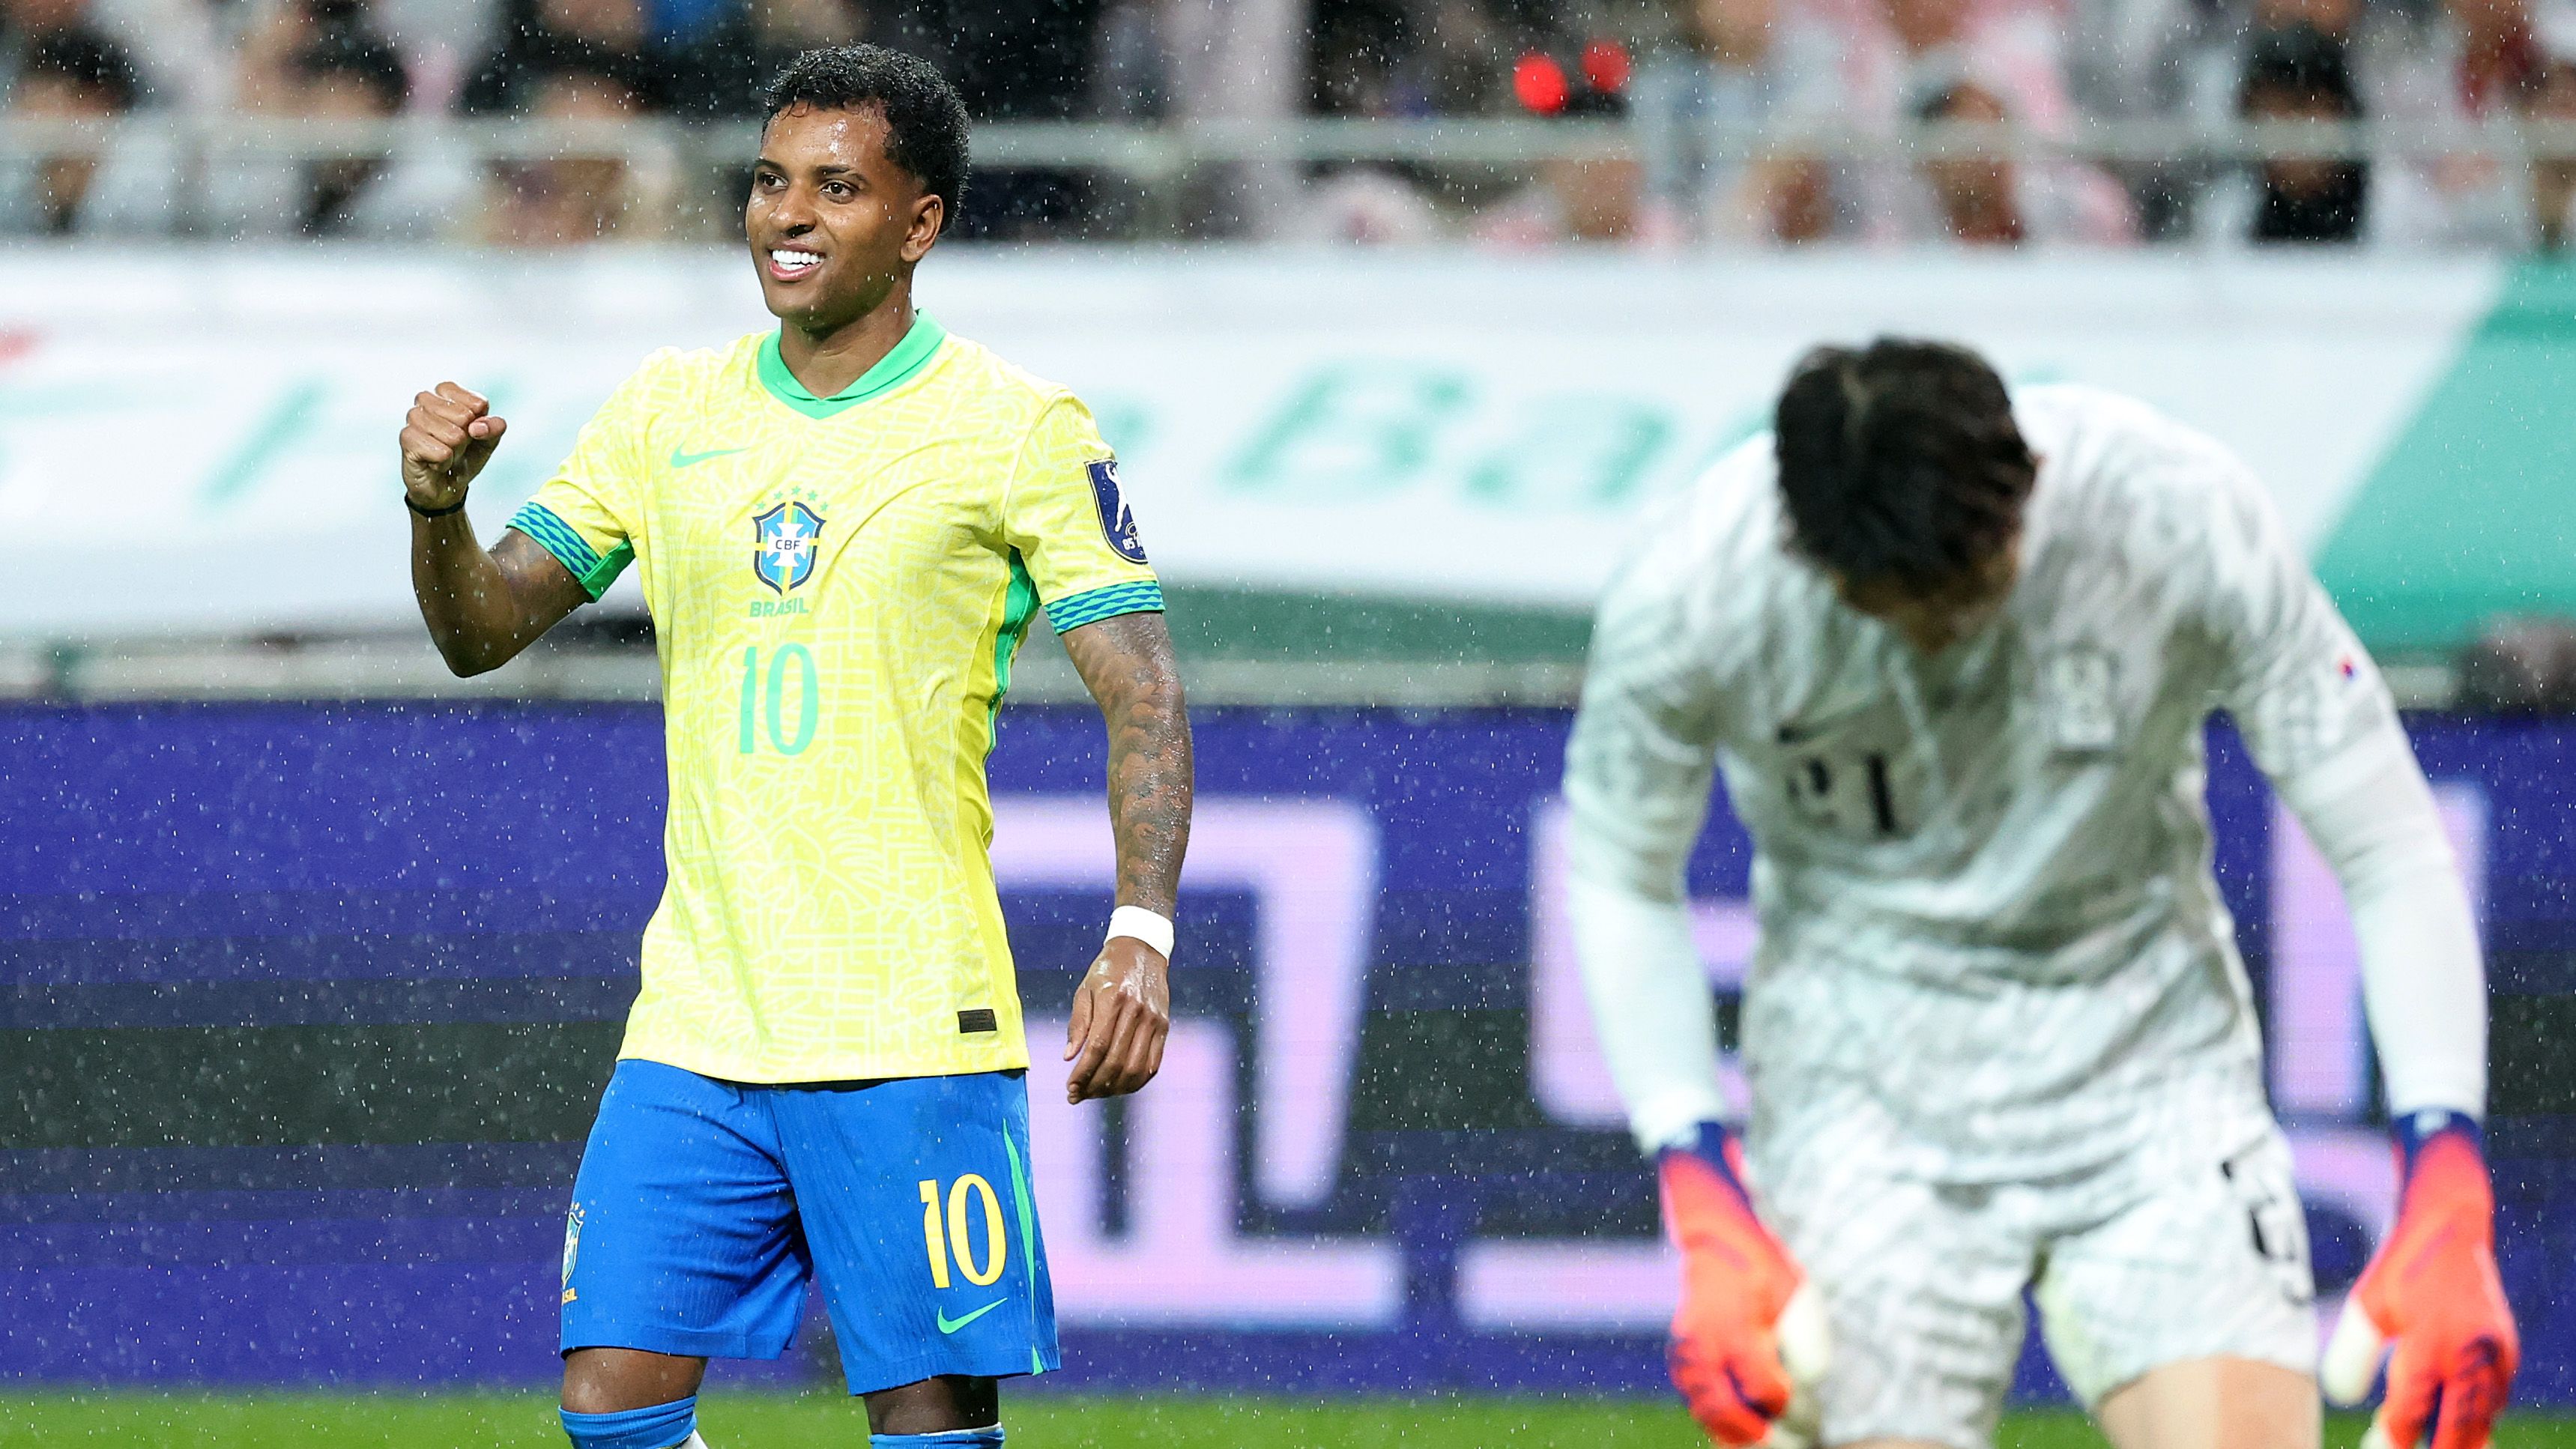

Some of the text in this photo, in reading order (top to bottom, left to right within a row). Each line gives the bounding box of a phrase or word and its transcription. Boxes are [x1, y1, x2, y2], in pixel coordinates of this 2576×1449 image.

[775, 539, 800, 550] CBF
[749, 597, 808, 617] BRASIL
[739, 643, 819, 756] 10
[919, 1173, 1007, 1289] 10
